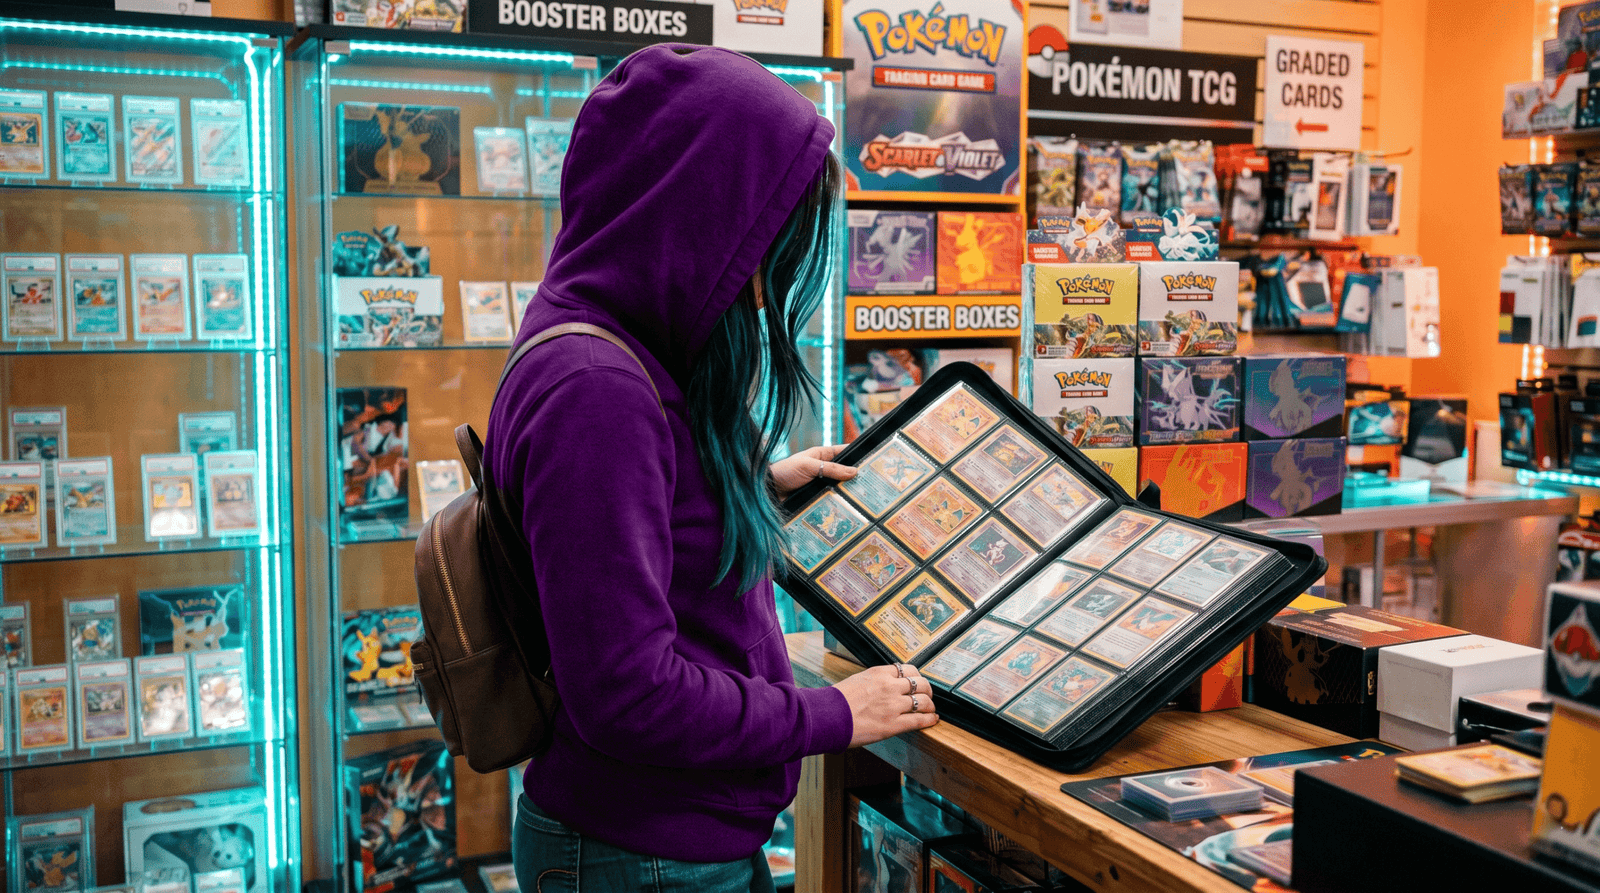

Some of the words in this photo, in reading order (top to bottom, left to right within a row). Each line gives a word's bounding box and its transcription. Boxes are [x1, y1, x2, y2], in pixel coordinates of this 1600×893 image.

[498, 0, 607, 32] BOOSTER
[613, 7, 688, 37] BOXES
[1276, 49, 1351, 77] GRADED
[1052, 56, 1182, 102] POKÉMON
[1188, 70, 1237, 106] TCG
[1281, 82, 1344, 109] CARDS
[855, 305, 950, 332] BOOSTER
[954, 304, 1020, 330] BOXES
